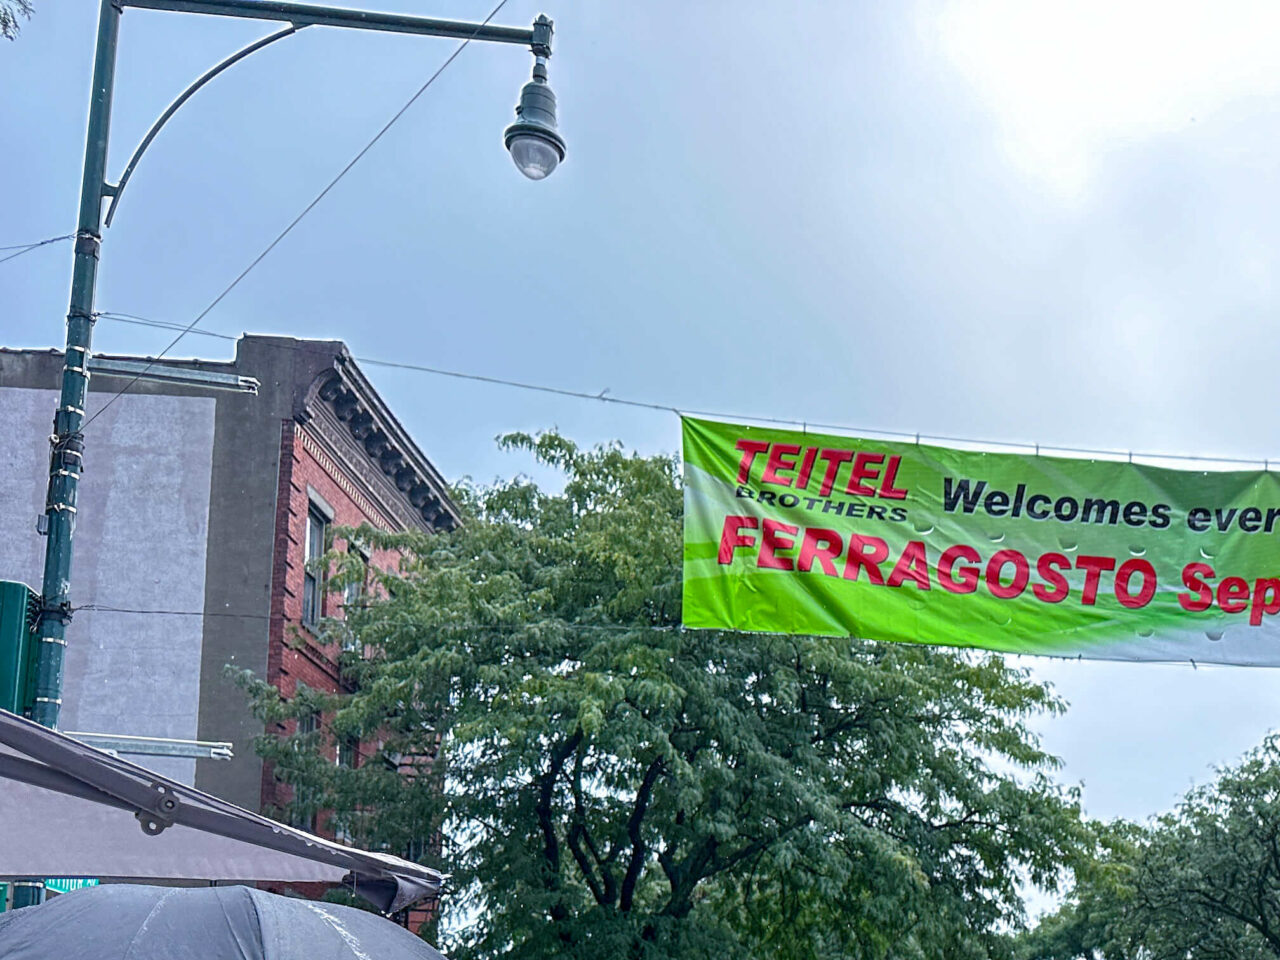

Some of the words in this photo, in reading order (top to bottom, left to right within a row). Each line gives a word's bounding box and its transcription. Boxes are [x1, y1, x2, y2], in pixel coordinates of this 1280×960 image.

[736, 440, 908, 499] TEITEL
[736, 485, 907, 522] BROTHERS
[944, 477, 1170, 529] Welcomes
[718, 515, 1157, 608] FERRAGOSTO
